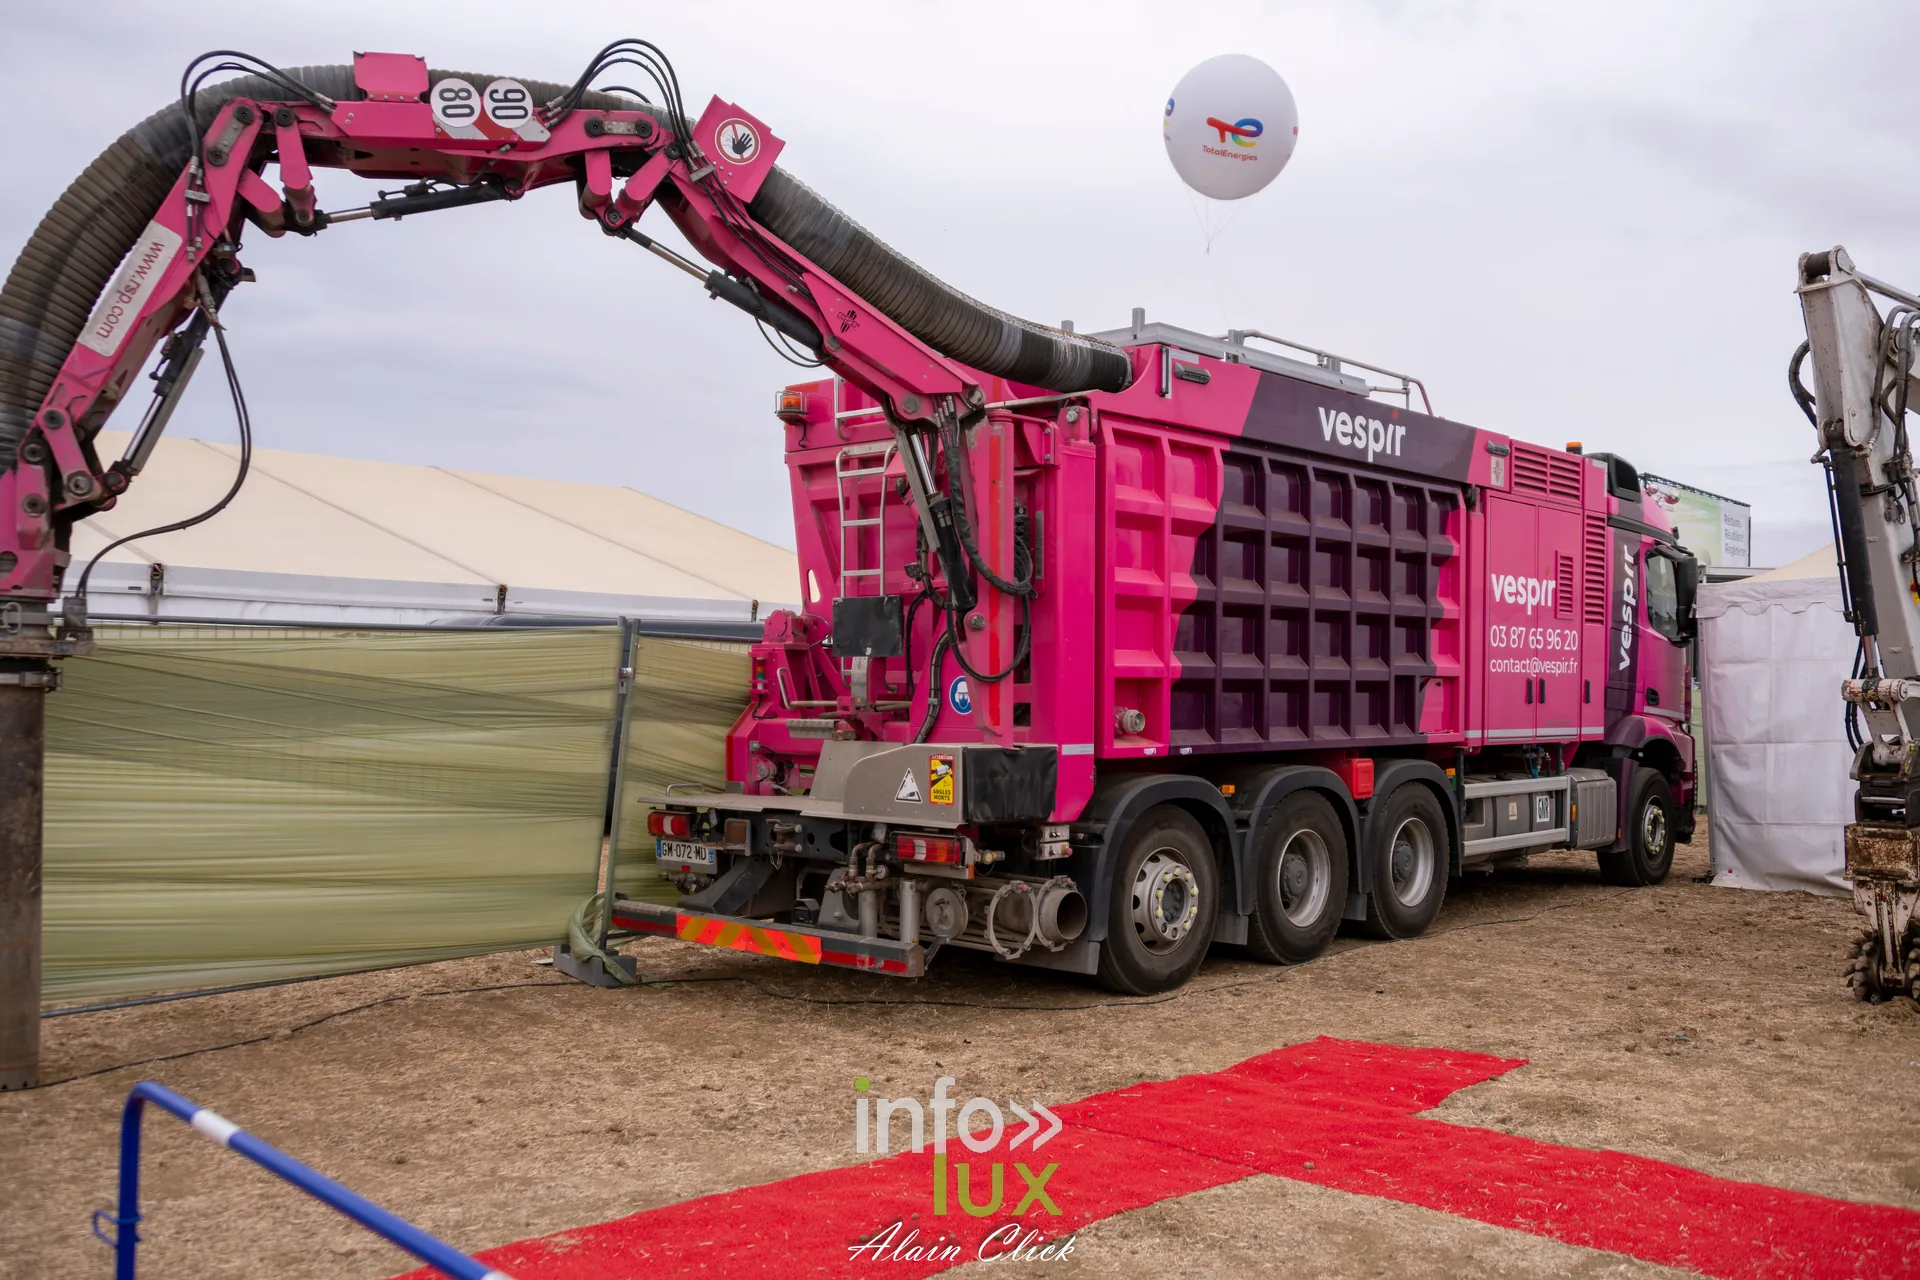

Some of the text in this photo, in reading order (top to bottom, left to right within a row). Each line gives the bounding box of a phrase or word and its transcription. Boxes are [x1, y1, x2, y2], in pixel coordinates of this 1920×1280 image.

[438, 87, 475, 119] 80
[488, 88, 529, 120] 90
[1202, 144, 1258, 161] TotalEnergies
[95, 241, 165, 338] www.rsp.com
[1318, 406, 1406, 463] vespir
[1491, 568, 1556, 615] vespir
[1618, 544, 1636, 671] vespir
[1490, 625, 1578, 651] 03 87 65 96 20
[1490, 657, 1578, 677] contact@vespir.fr
[932, 788, 951, 796] ANGLES
[662, 842, 707, 861] GM-072-MD
